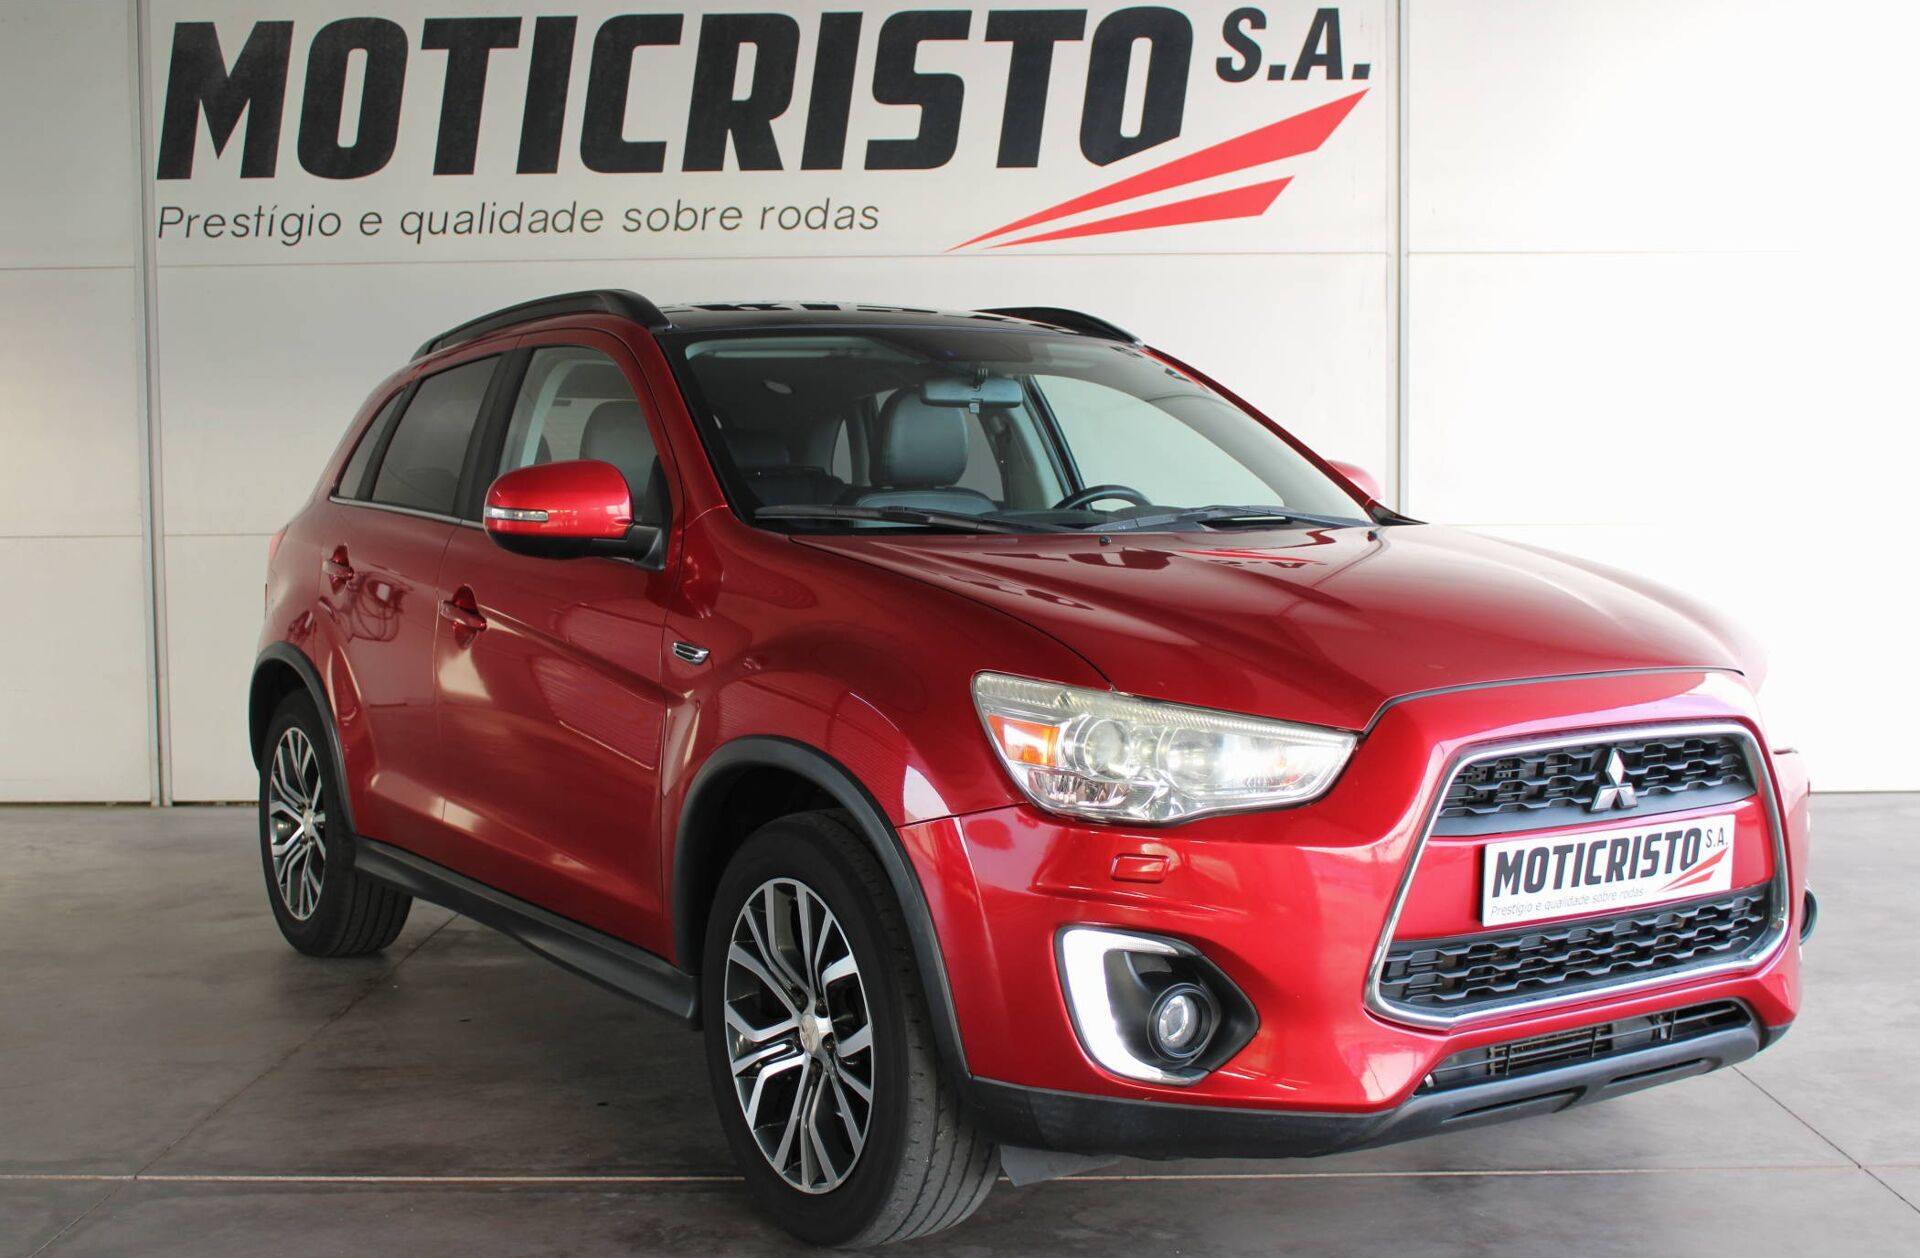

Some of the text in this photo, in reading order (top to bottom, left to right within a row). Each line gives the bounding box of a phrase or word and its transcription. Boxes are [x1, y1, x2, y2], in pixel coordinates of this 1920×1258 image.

[156, 6, 1371, 180] MOTICRISTO S.A.
[158, 198, 879, 246] Prestígio e qualidade sobre rodas
[1492, 827, 1702, 898] MOTICRISTO
[1536, 902, 1541, 911] e
[1544, 894, 1590, 912] qualidade
[1592, 887, 1617, 904] sobre
[1618, 886, 1644, 901] rodas
